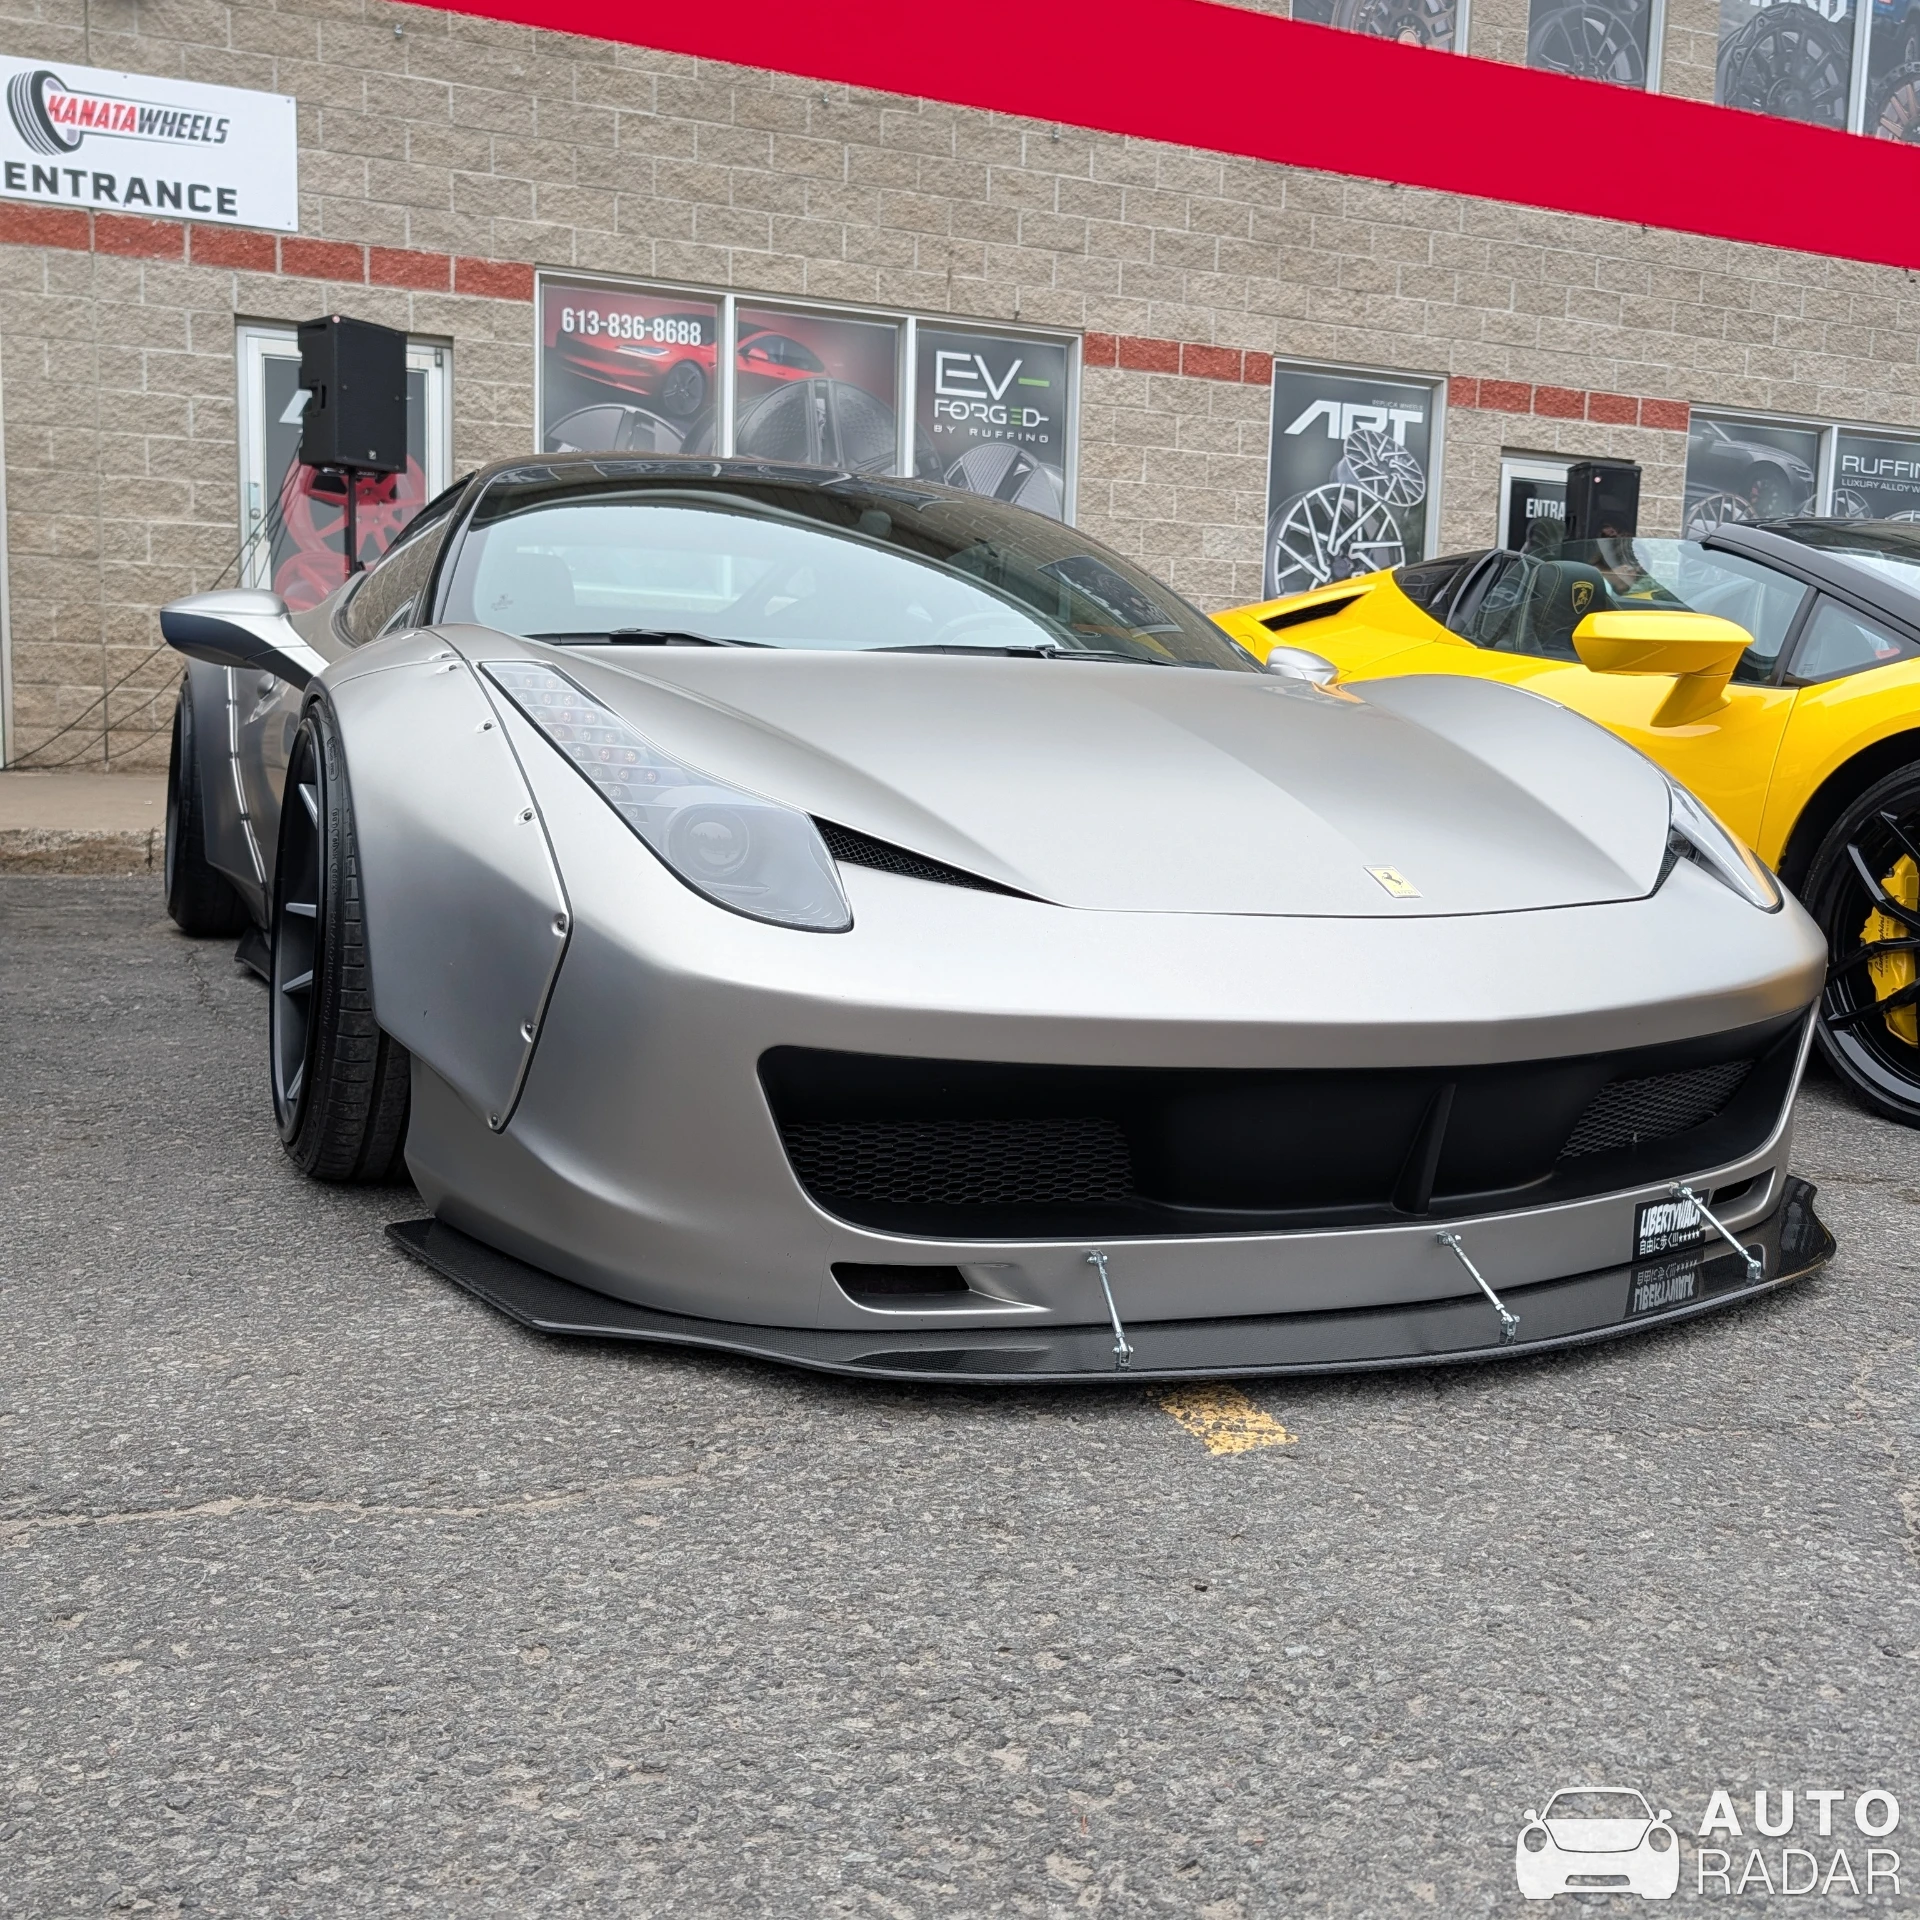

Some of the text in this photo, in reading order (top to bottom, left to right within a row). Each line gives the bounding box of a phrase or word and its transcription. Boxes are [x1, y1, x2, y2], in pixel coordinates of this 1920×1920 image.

[4, 160, 238, 217] ENTRANCE
[561, 307, 703, 347] 613-836-8688
[933, 425, 1049, 443] BY RUFFINO
[1283, 399, 1424, 447] ART
[1841, 478, 1880, 489] LUXURY
[1880, 482, 1911, 492] ALLOY
